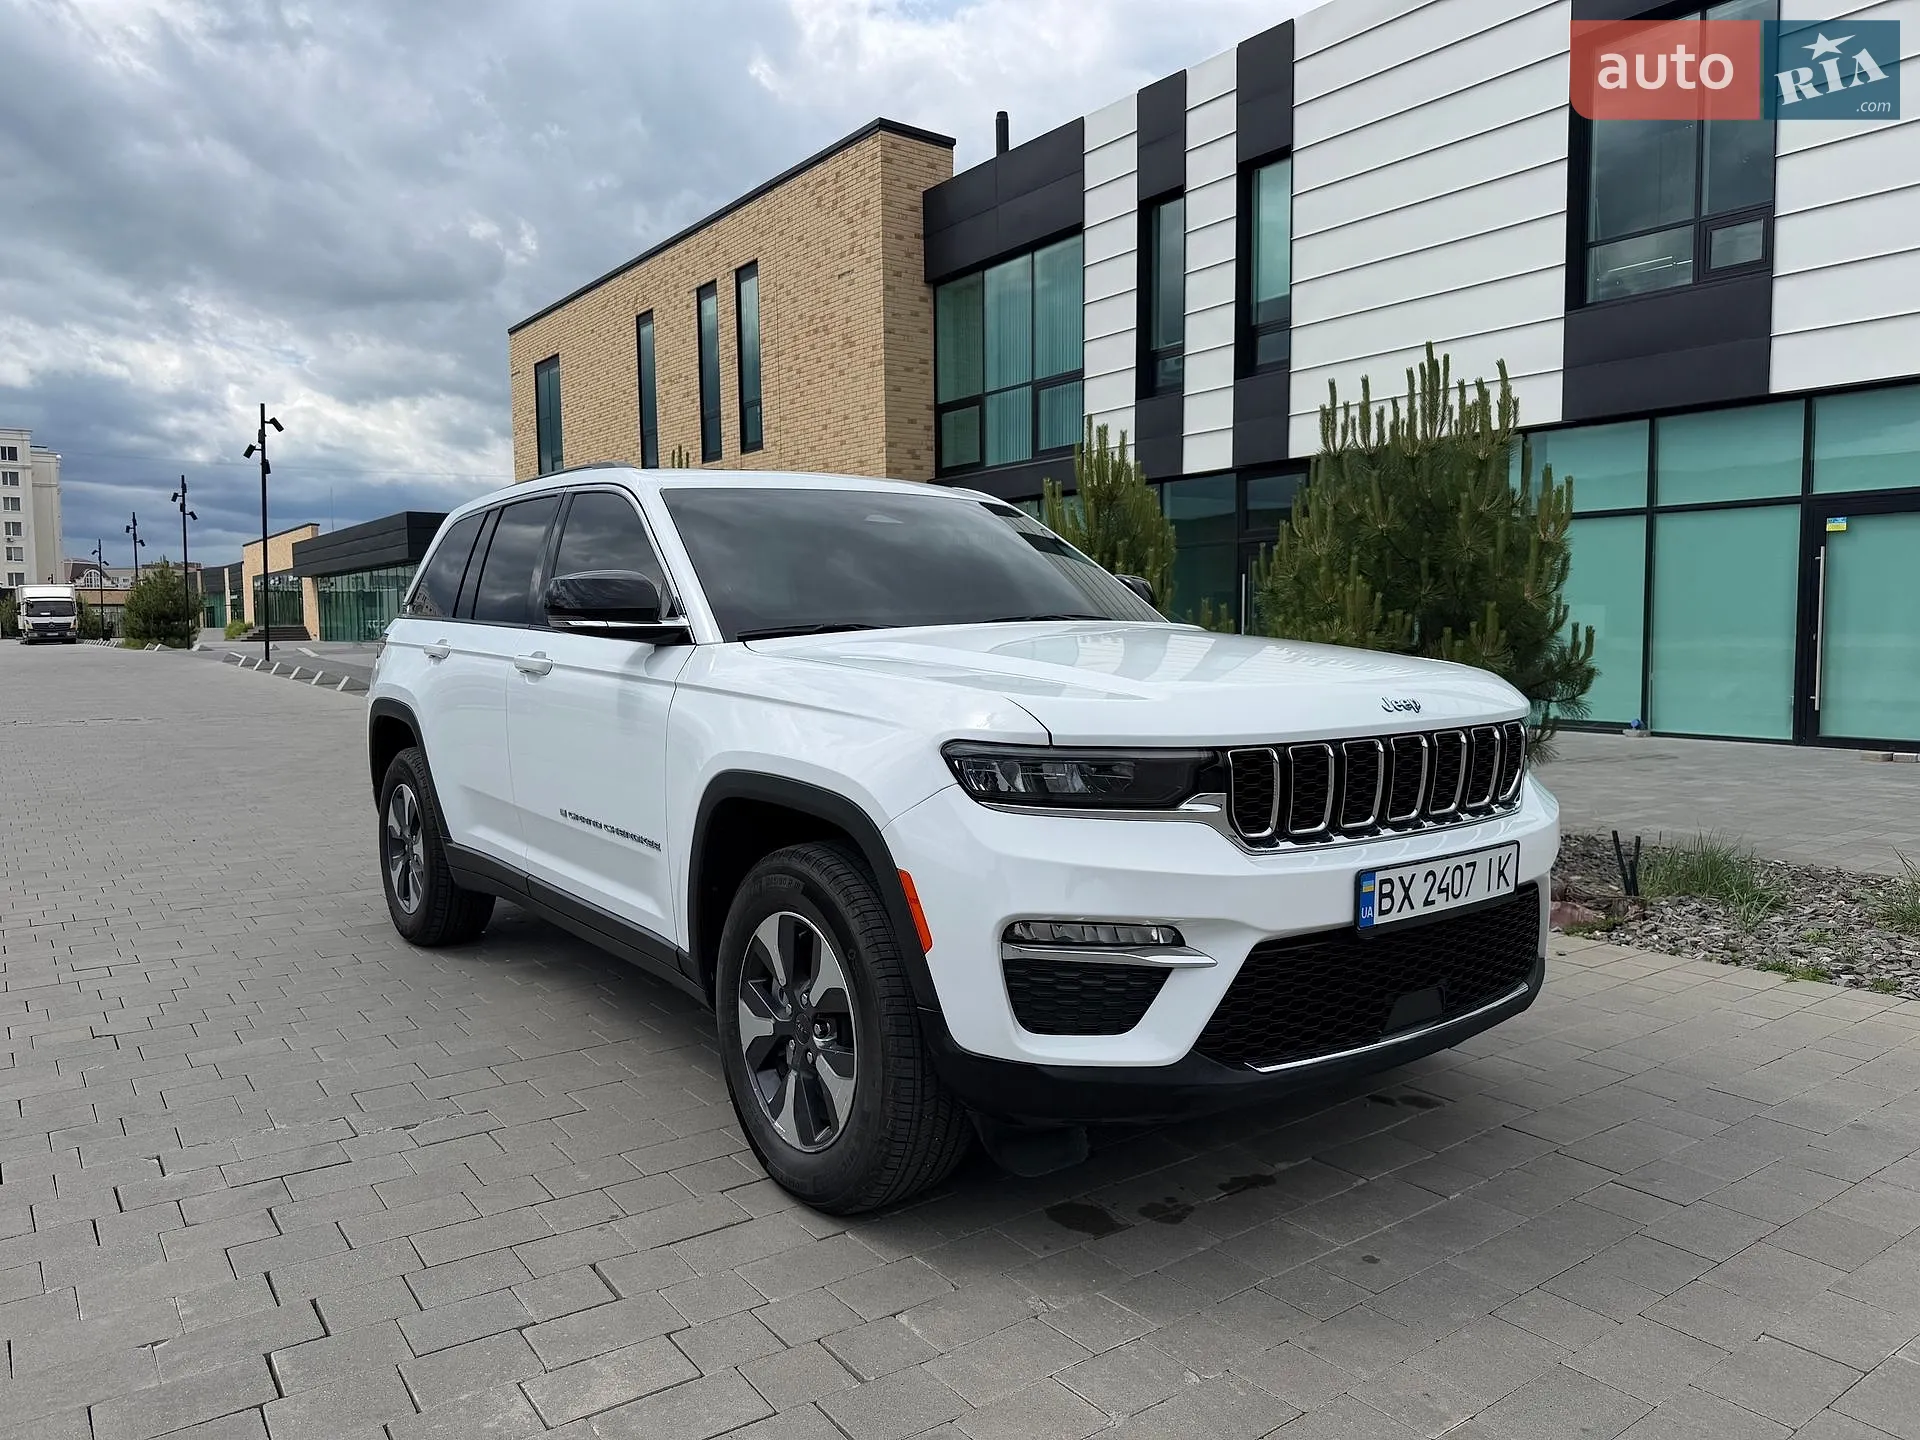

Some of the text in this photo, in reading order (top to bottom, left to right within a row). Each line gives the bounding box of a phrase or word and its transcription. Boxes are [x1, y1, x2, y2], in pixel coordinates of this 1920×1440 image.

[1381, 696, 1420, 713] Jeep
[1377, 852, 1512, 917] BX 2407 IK
[1361, 906, 1374, 919] UA
